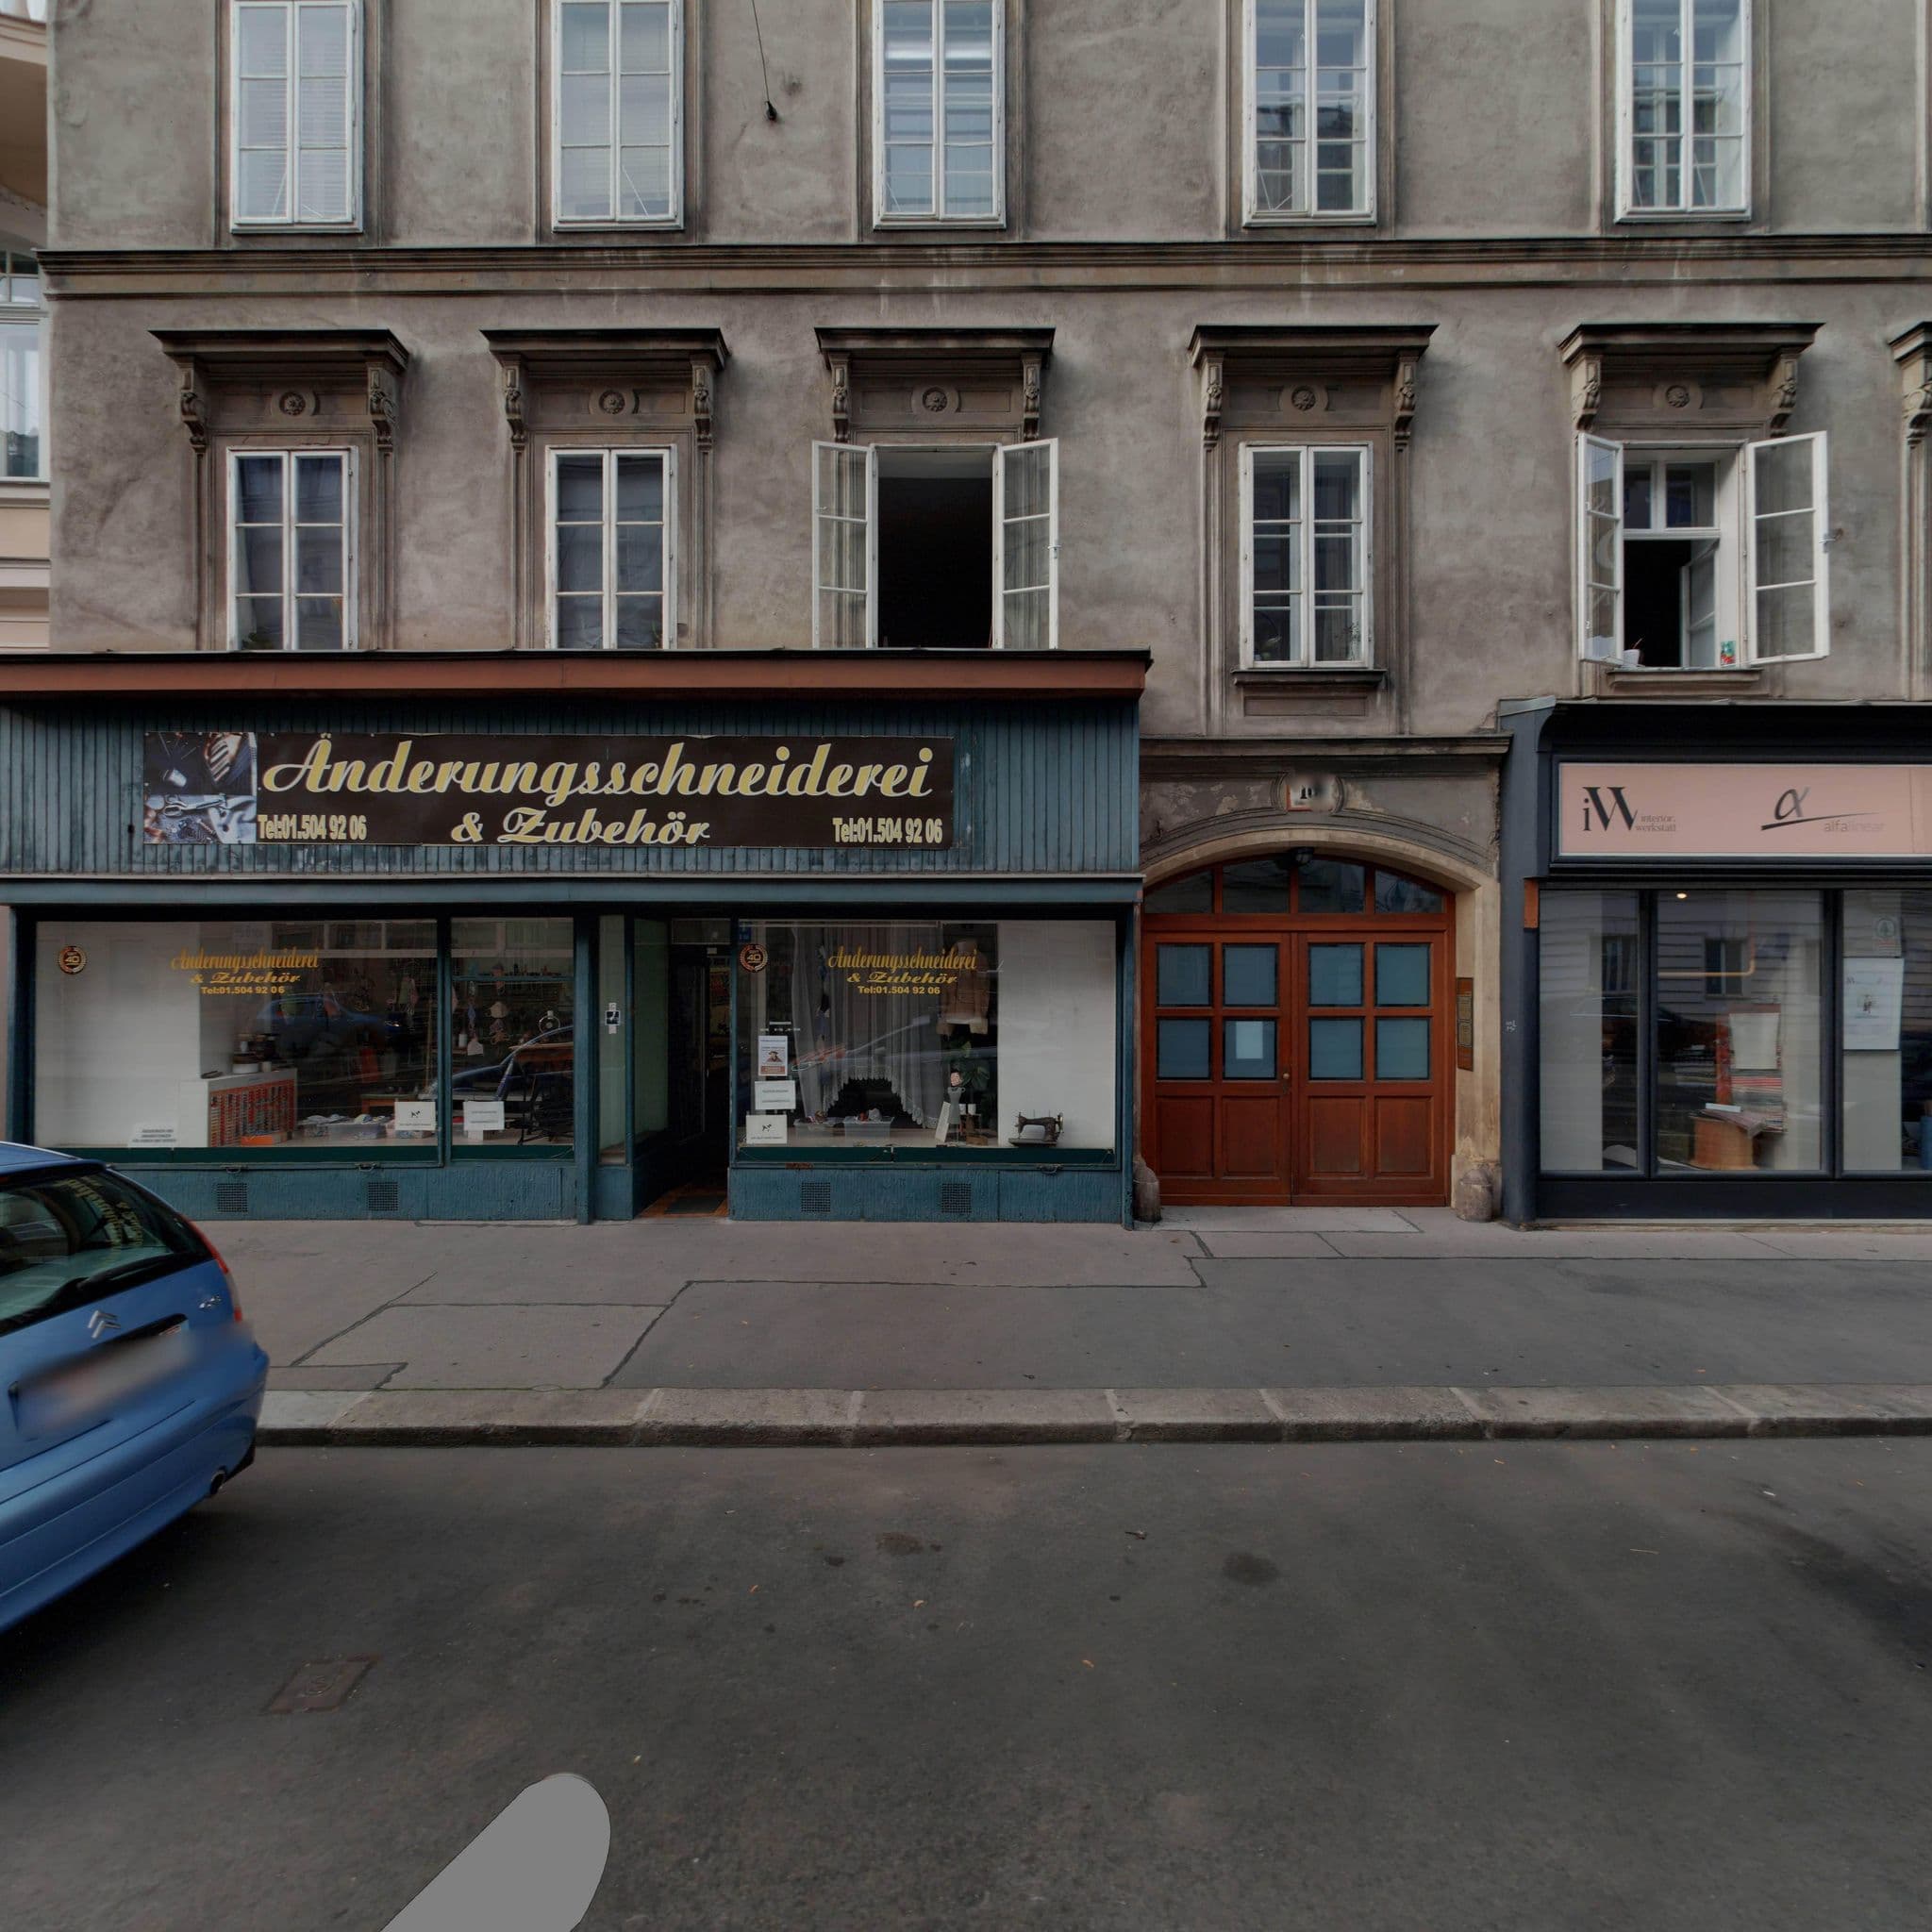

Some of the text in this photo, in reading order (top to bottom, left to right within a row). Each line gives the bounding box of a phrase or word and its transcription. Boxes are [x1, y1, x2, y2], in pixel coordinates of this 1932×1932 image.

[262, 732, 934, 808] Änderungsschneiderei
[328, 814, 347, 841] 92
[348, 814, 368, 841] 06
[450, 807, 710, 844] & Zubehör
[904, 817, 924, 843] 92
[924, 817, 943, 844] 06
[209, 972, 301, 984] Zubehör
[846, 971, 958, 984] & Zubehör
[256, 986, 268, 994] 92
[270, 986, 286, 994] 06
[912, 986, 925, 994] 92
[927, 986, 941, 995] 06
